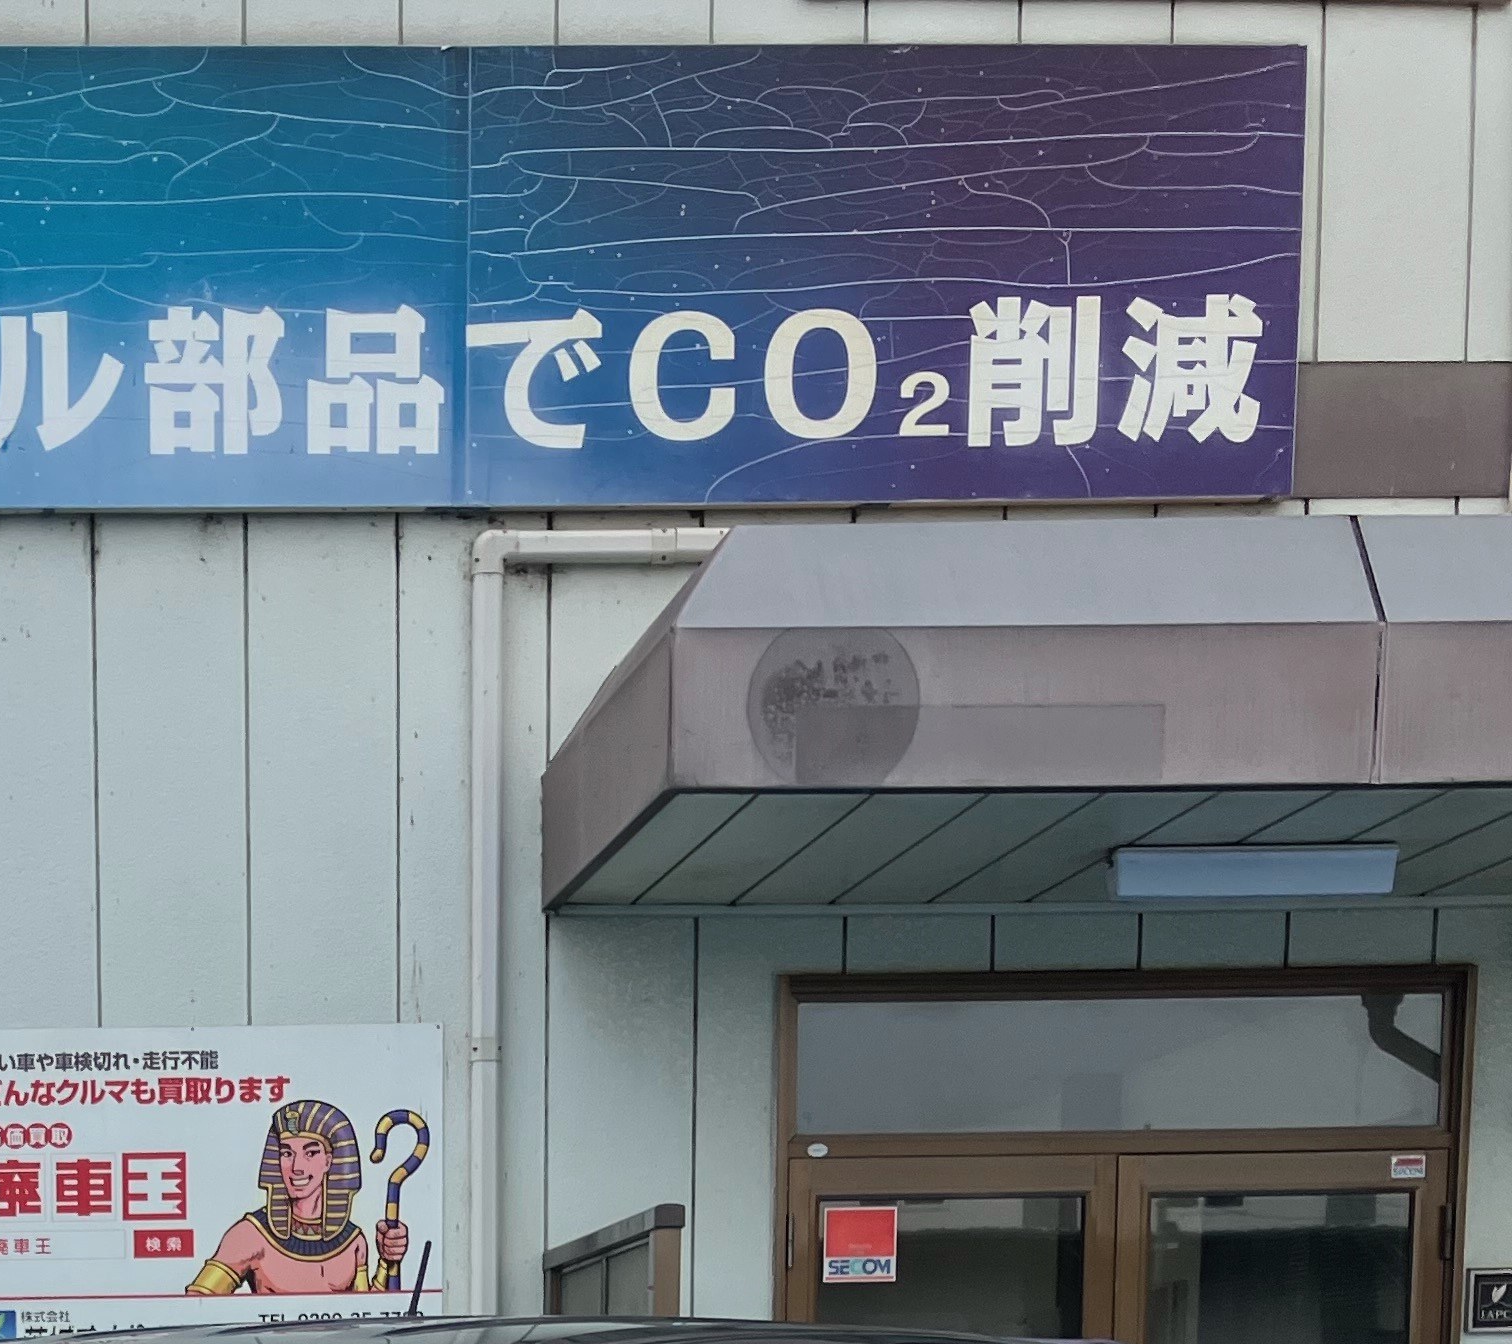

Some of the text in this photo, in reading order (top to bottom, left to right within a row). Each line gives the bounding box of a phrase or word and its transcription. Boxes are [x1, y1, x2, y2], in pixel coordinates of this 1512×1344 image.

[145, 1236, 182, 1252] 検索
[828, 1258, 891, 1276] SECOM
[20, 1310, 71, 1323] 株式会社
